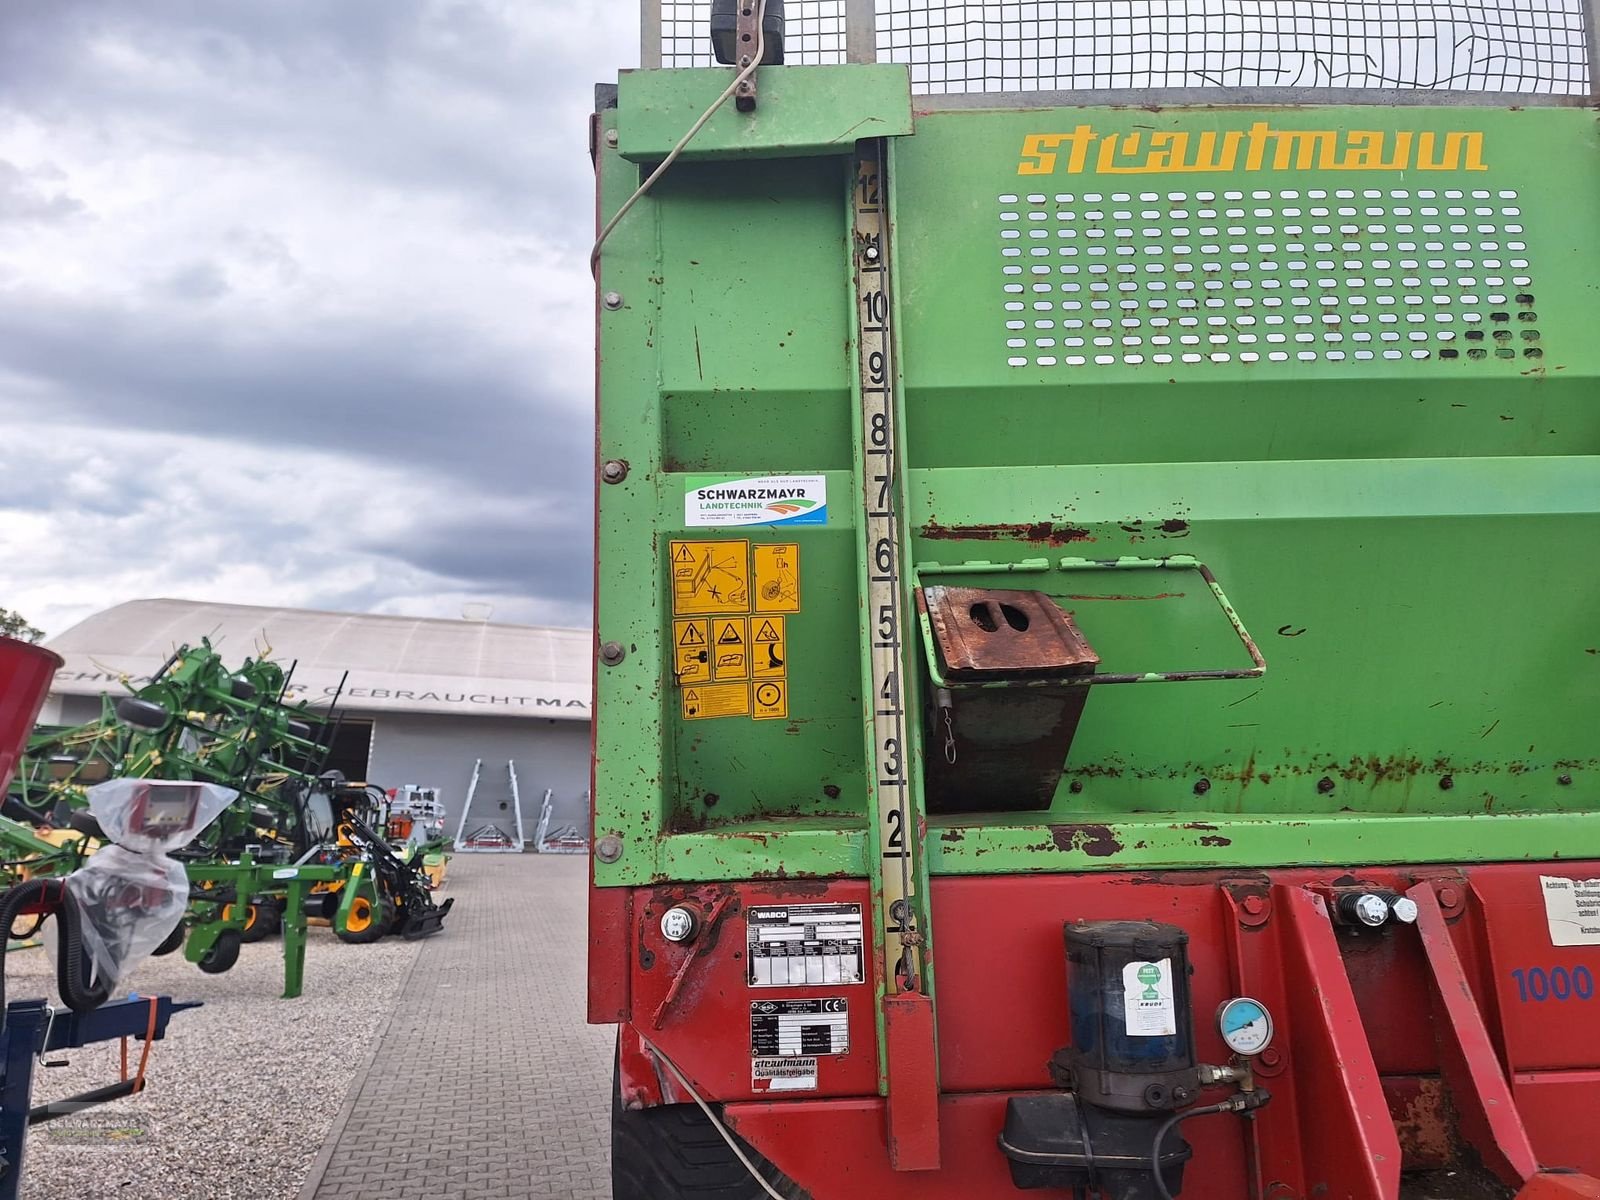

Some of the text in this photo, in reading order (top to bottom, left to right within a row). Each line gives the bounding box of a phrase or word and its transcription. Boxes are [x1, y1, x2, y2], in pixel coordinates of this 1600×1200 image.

[863, 291, 888, 323] 10
[869, 351, 887, 384] 9
[871, 413, 889, 446] 8
[697, 488, 806, 500] SCHWARZMAYR
[700, 502, 763, 510] LANDTECHNIK
[874, 476, 891, 508] 7
[875, 537, 893, 573] 6
[879, 605, 896, 640] 5
[881, 671, 898, 706] 4
[884, 738, 901, 776] 3
[887, 809, 903, 848] 2
[757, 911, 787, 919] WABCO
[1512, 964, 1594, 1003] 1000
[754, 1059, 815, 1067] strautmann
[754, 1069, 815, 1077] Qualitätsfreigabe
